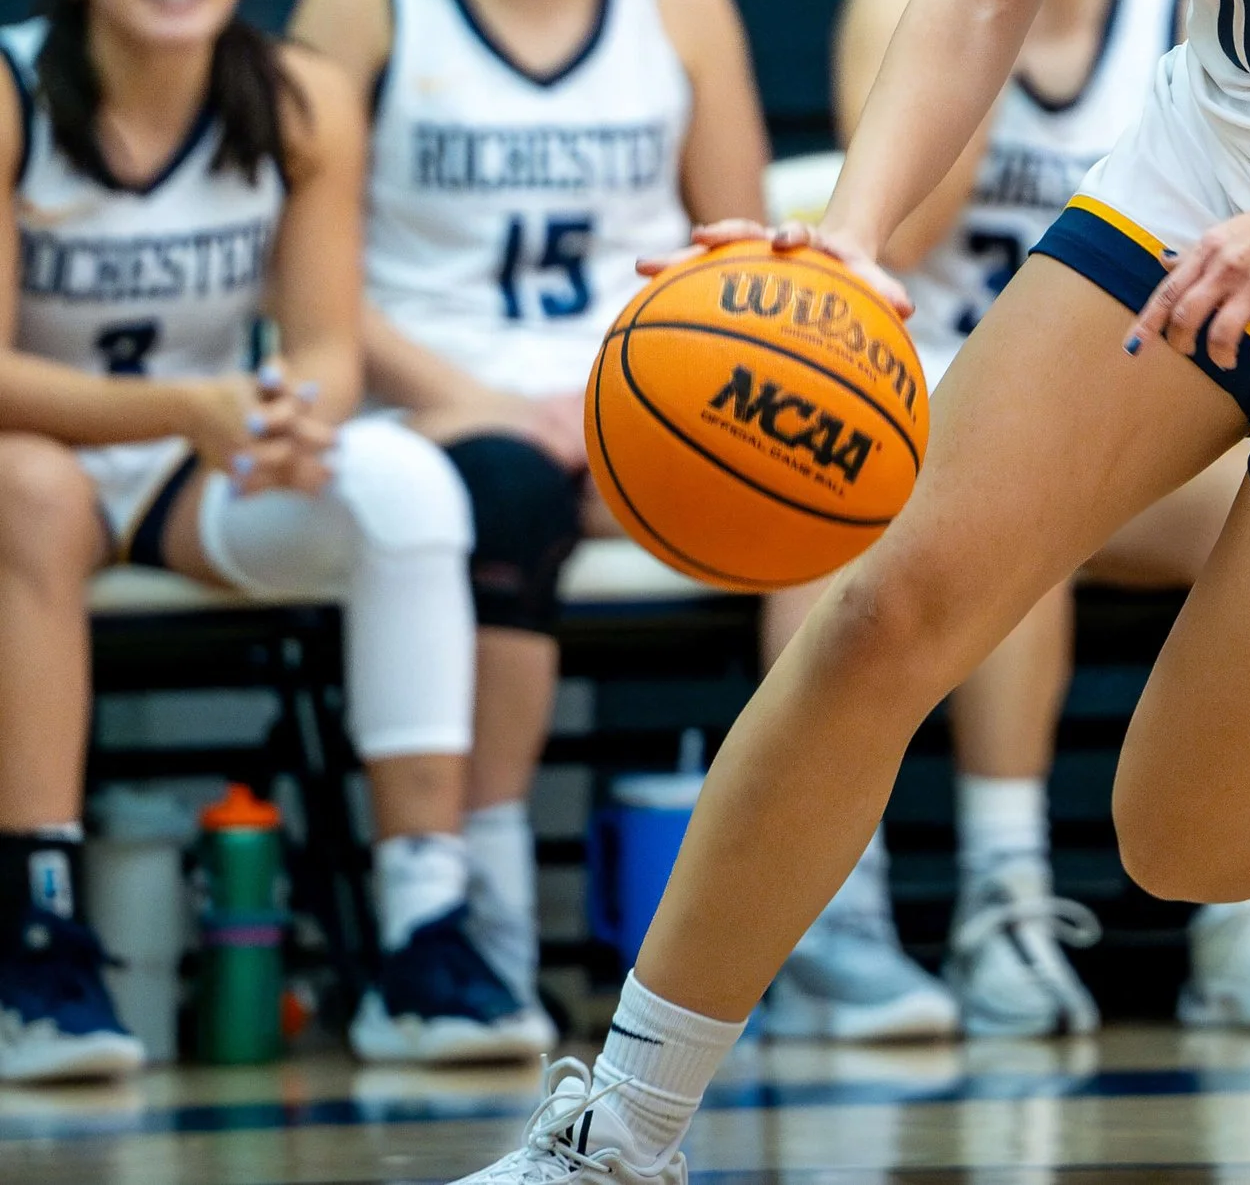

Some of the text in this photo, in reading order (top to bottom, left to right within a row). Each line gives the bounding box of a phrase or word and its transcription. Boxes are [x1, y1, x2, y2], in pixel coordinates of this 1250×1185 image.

[498, 214, 598, 321] 15
[718, 270, 918, 420] Wilson
[708, 364, 874, 485] NCAA
